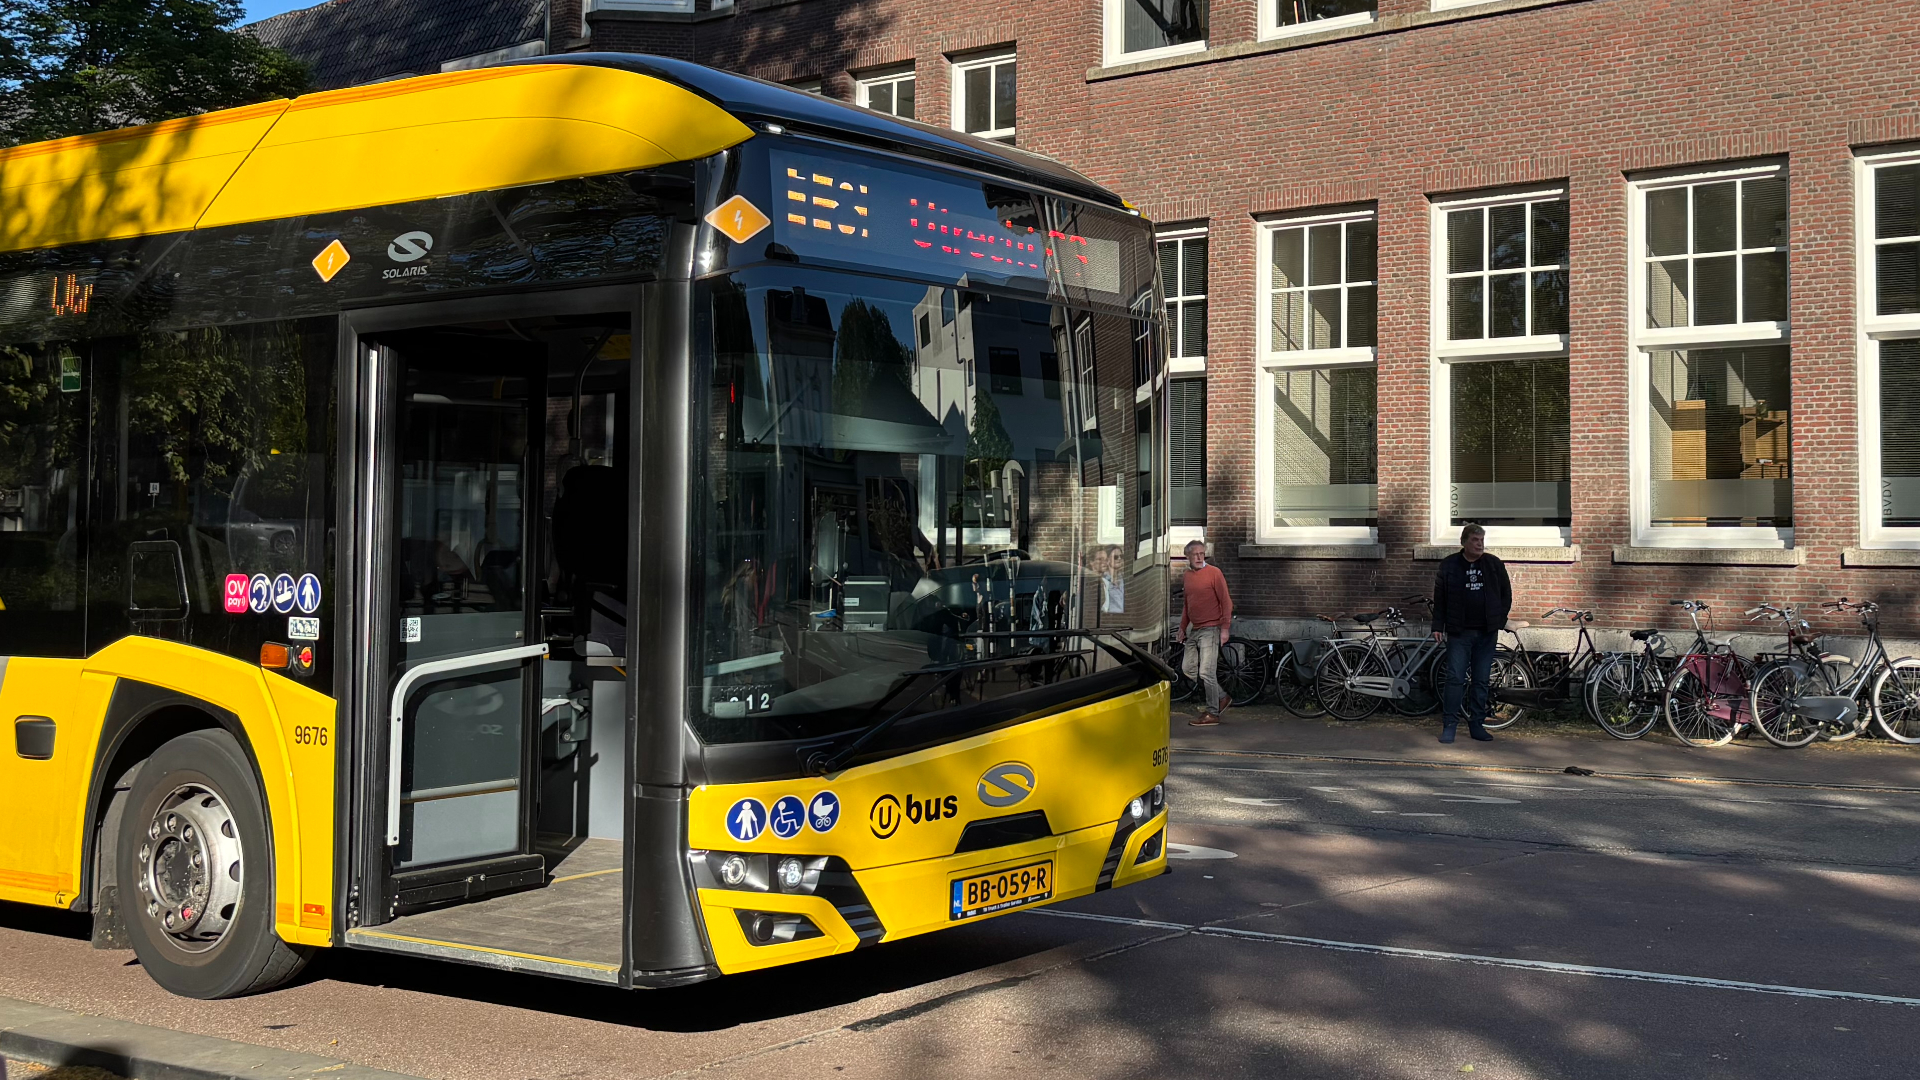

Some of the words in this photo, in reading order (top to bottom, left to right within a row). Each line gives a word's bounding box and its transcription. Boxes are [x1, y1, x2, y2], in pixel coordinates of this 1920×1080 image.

[382, 265, 428, 279] SOLARIS
[1451, 486, 1459, 516] BVDV
[1883, 480, 1892, 515] BVDV
[227, 580, 246, 595] OV
[227, 597, 241, 607] pay
[295, 725, 328, 746] 9676
[1152, 746, 1168, 767] 9676
[906, 793, 958, 825] bus
[968, 867, 1047, 905] BB-059-R
[953, 899, 962, 908] NL
